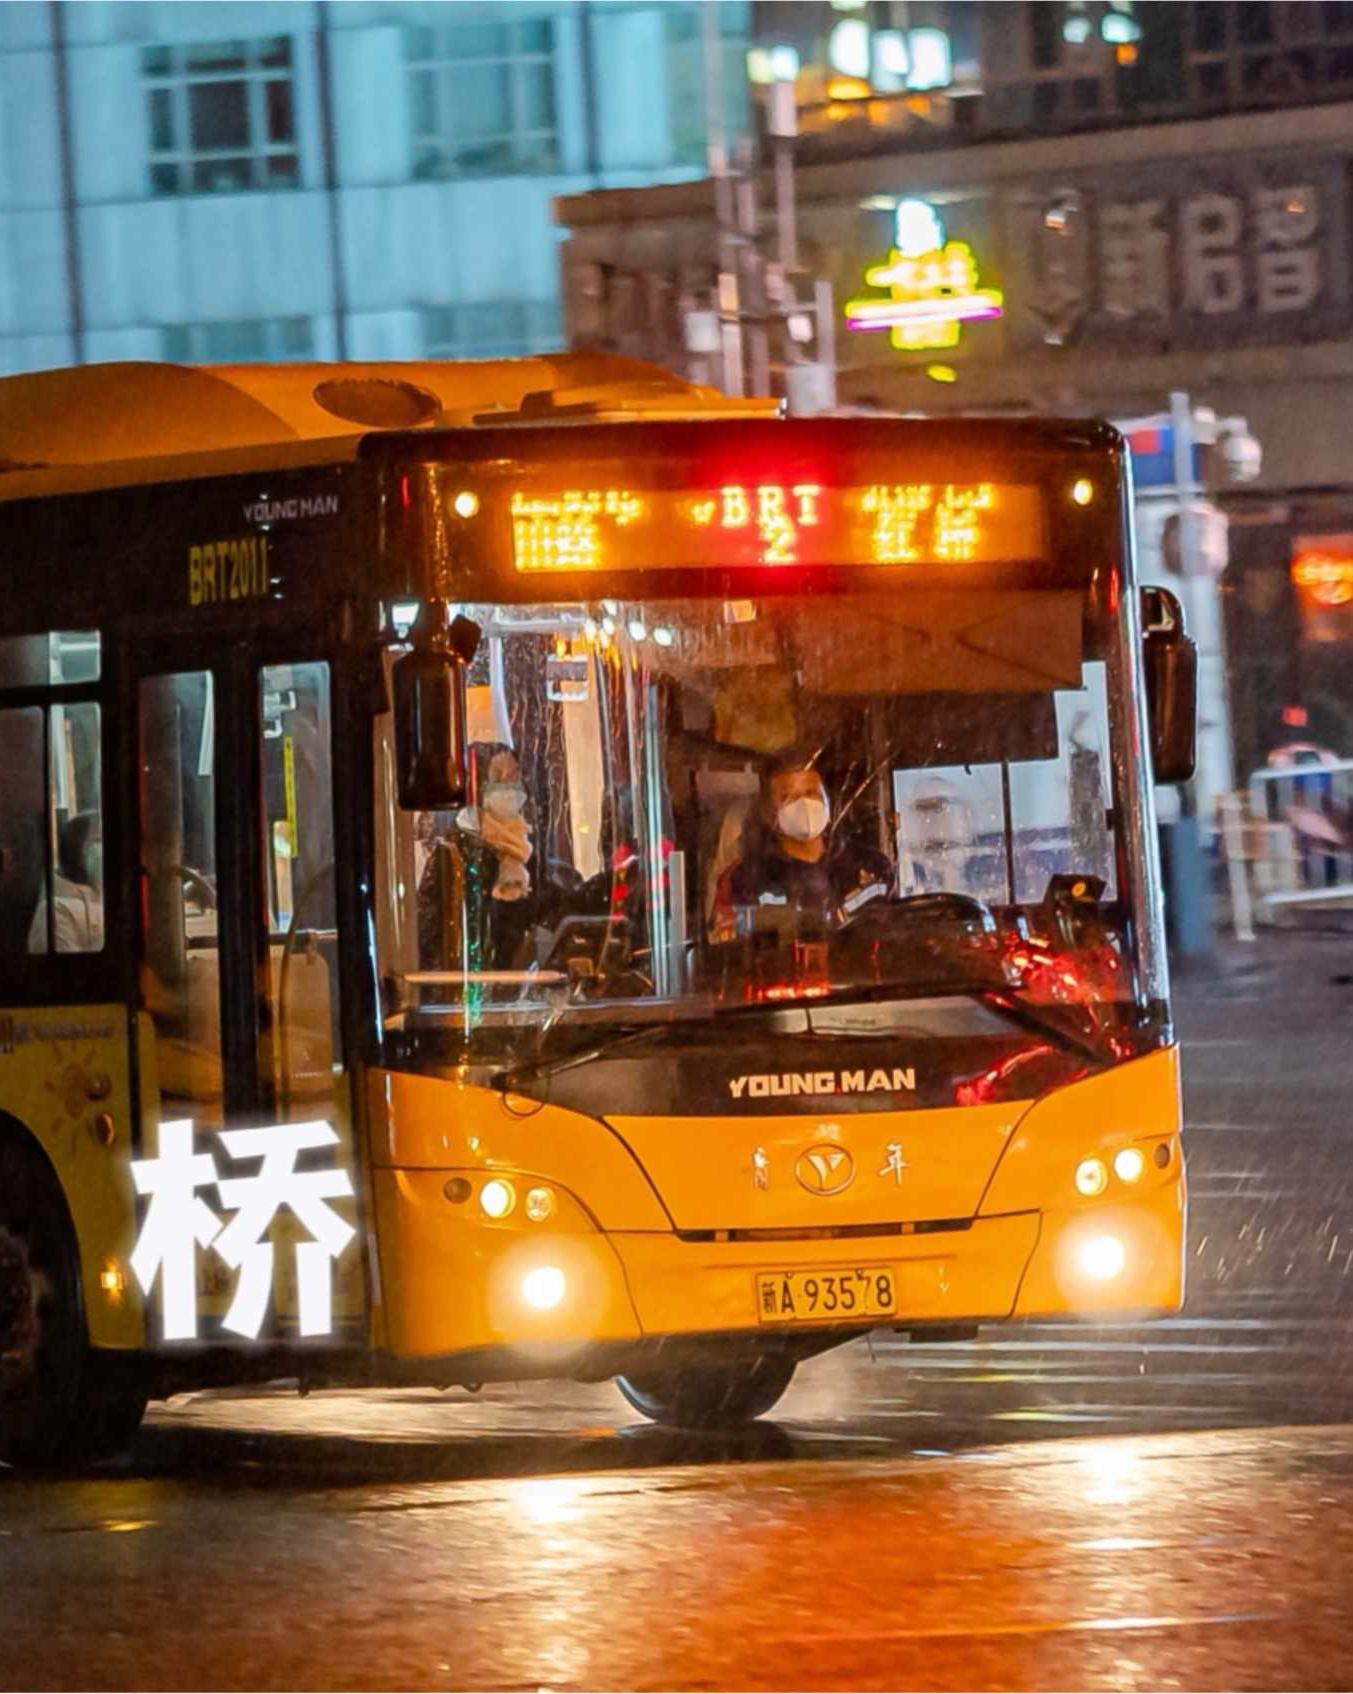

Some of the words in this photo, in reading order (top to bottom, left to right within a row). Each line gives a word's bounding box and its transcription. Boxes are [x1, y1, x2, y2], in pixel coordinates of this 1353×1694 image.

[720, 486, 820, 526] BRT
[762, 519, 796, 564] 2
[189, 536, 269, 606] BRT2011
